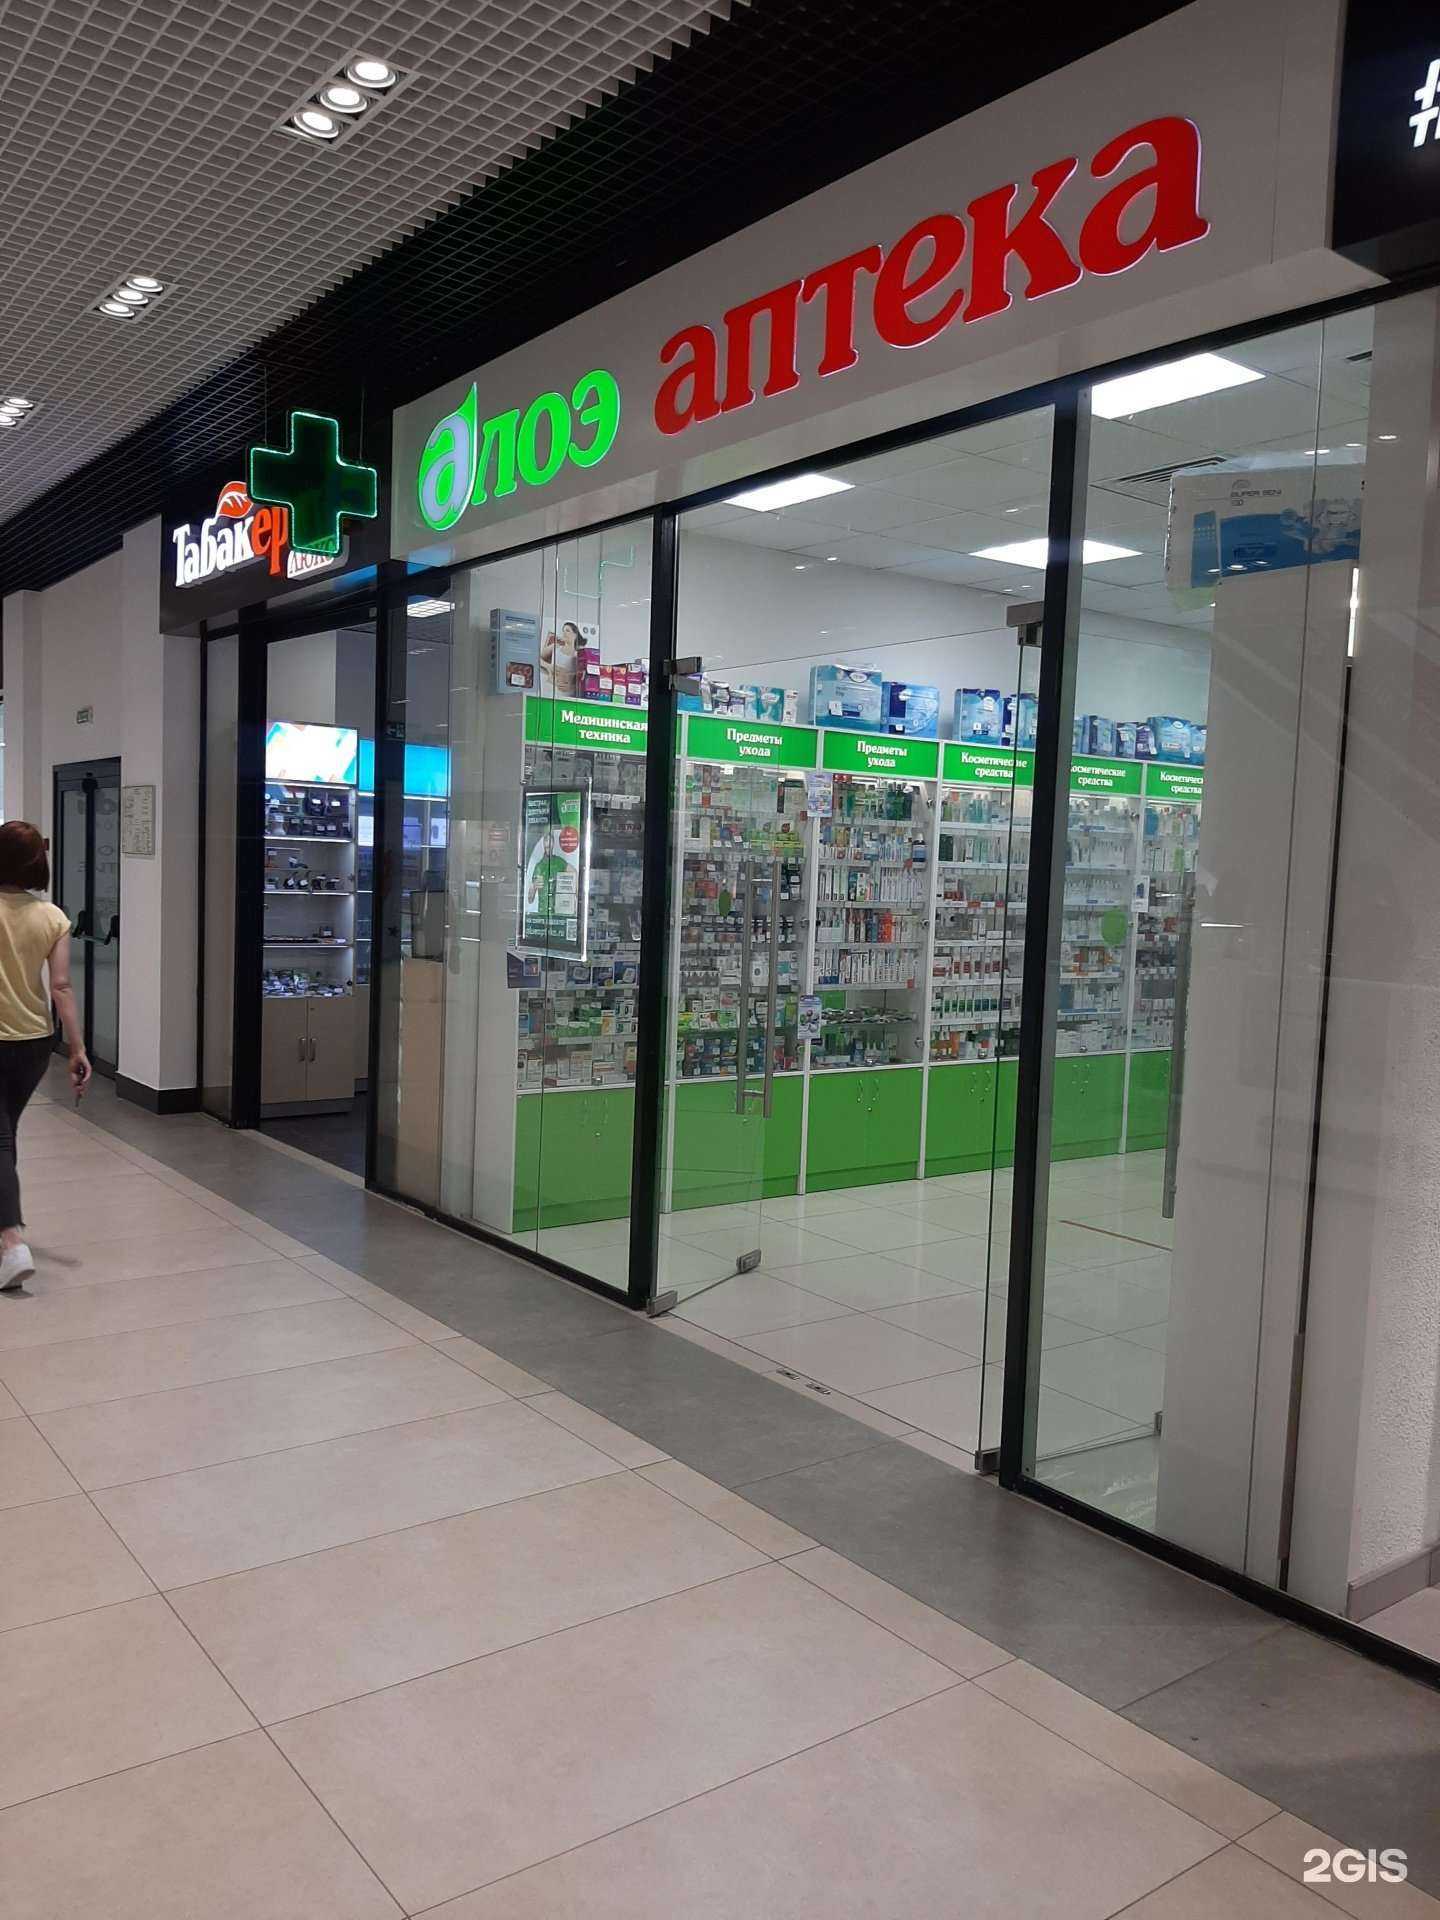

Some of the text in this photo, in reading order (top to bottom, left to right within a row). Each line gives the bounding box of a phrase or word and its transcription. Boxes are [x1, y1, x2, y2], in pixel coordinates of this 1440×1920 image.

[654, 116, 1211, 436] аптека
[561, 710, 649, 732] Медицинская
[578, 727, 631, 744] техника
[727, 727, 783, 745] Предметы
[739, 744, 771, 757] ухода
[857, 740, 908, 755] Предметы
[867, 756, 896, 768] ухода
[961, 751, 1028, 768] Косметичесие
[974, 767, 1014, 778] средства
[1070, 765, 1127, 778] осметические
[1077, 776, 1114, 787] средства
